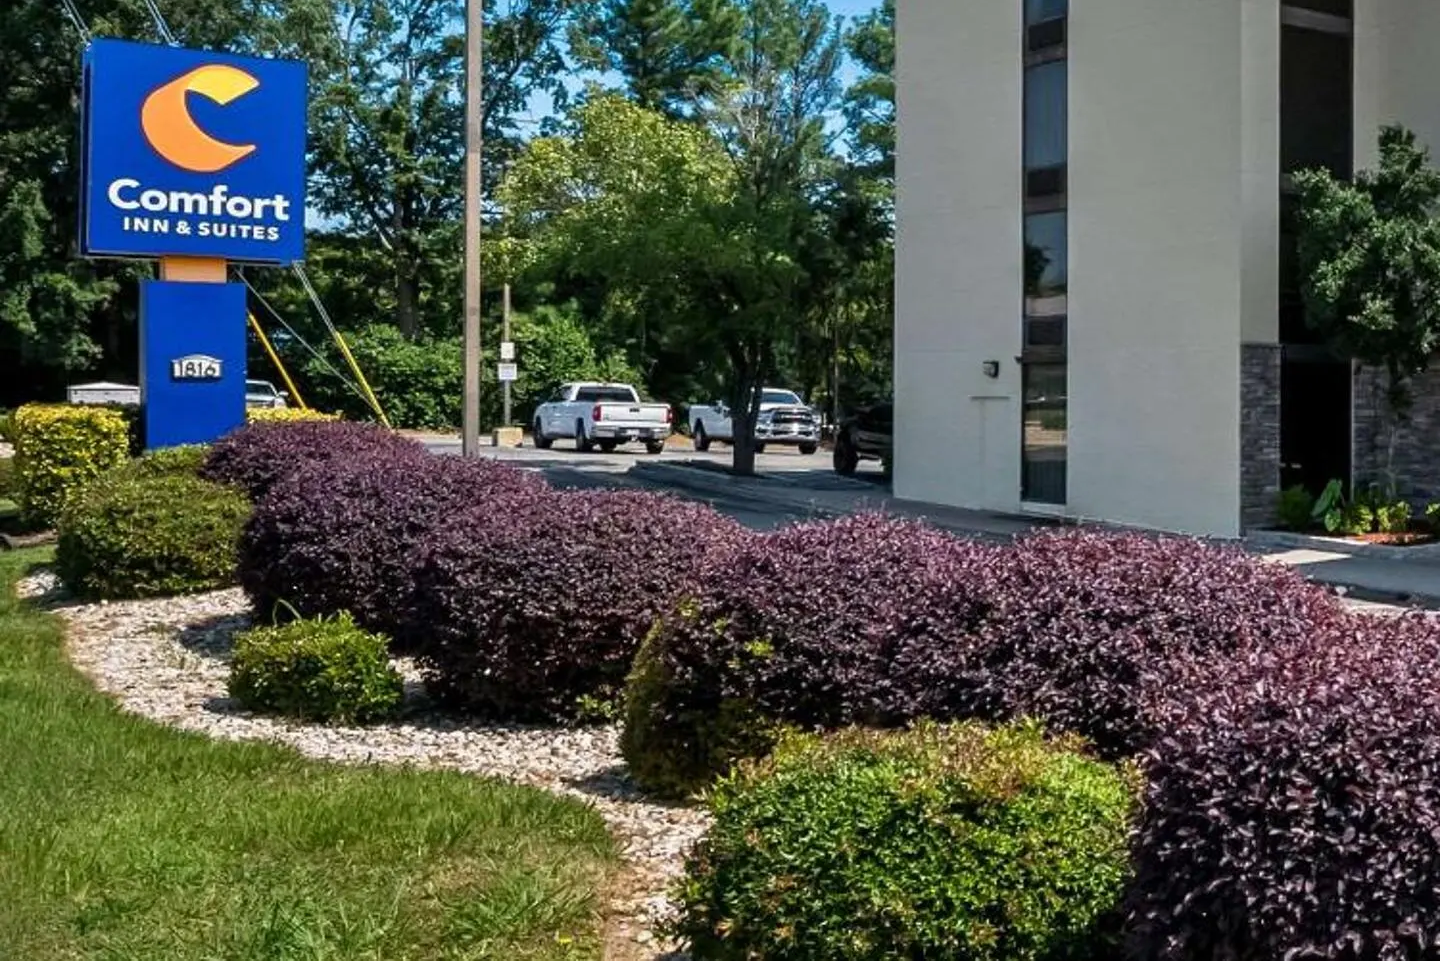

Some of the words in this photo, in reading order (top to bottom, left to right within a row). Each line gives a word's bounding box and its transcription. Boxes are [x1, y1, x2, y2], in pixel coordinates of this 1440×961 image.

[108, 178, 290, 221] Comfort
[123, 216, 170, 233] INN
[176, 220, 192, 235] &
[198, 222, 280, 241] SUITES
[179, 359, 216, 376] 1816
